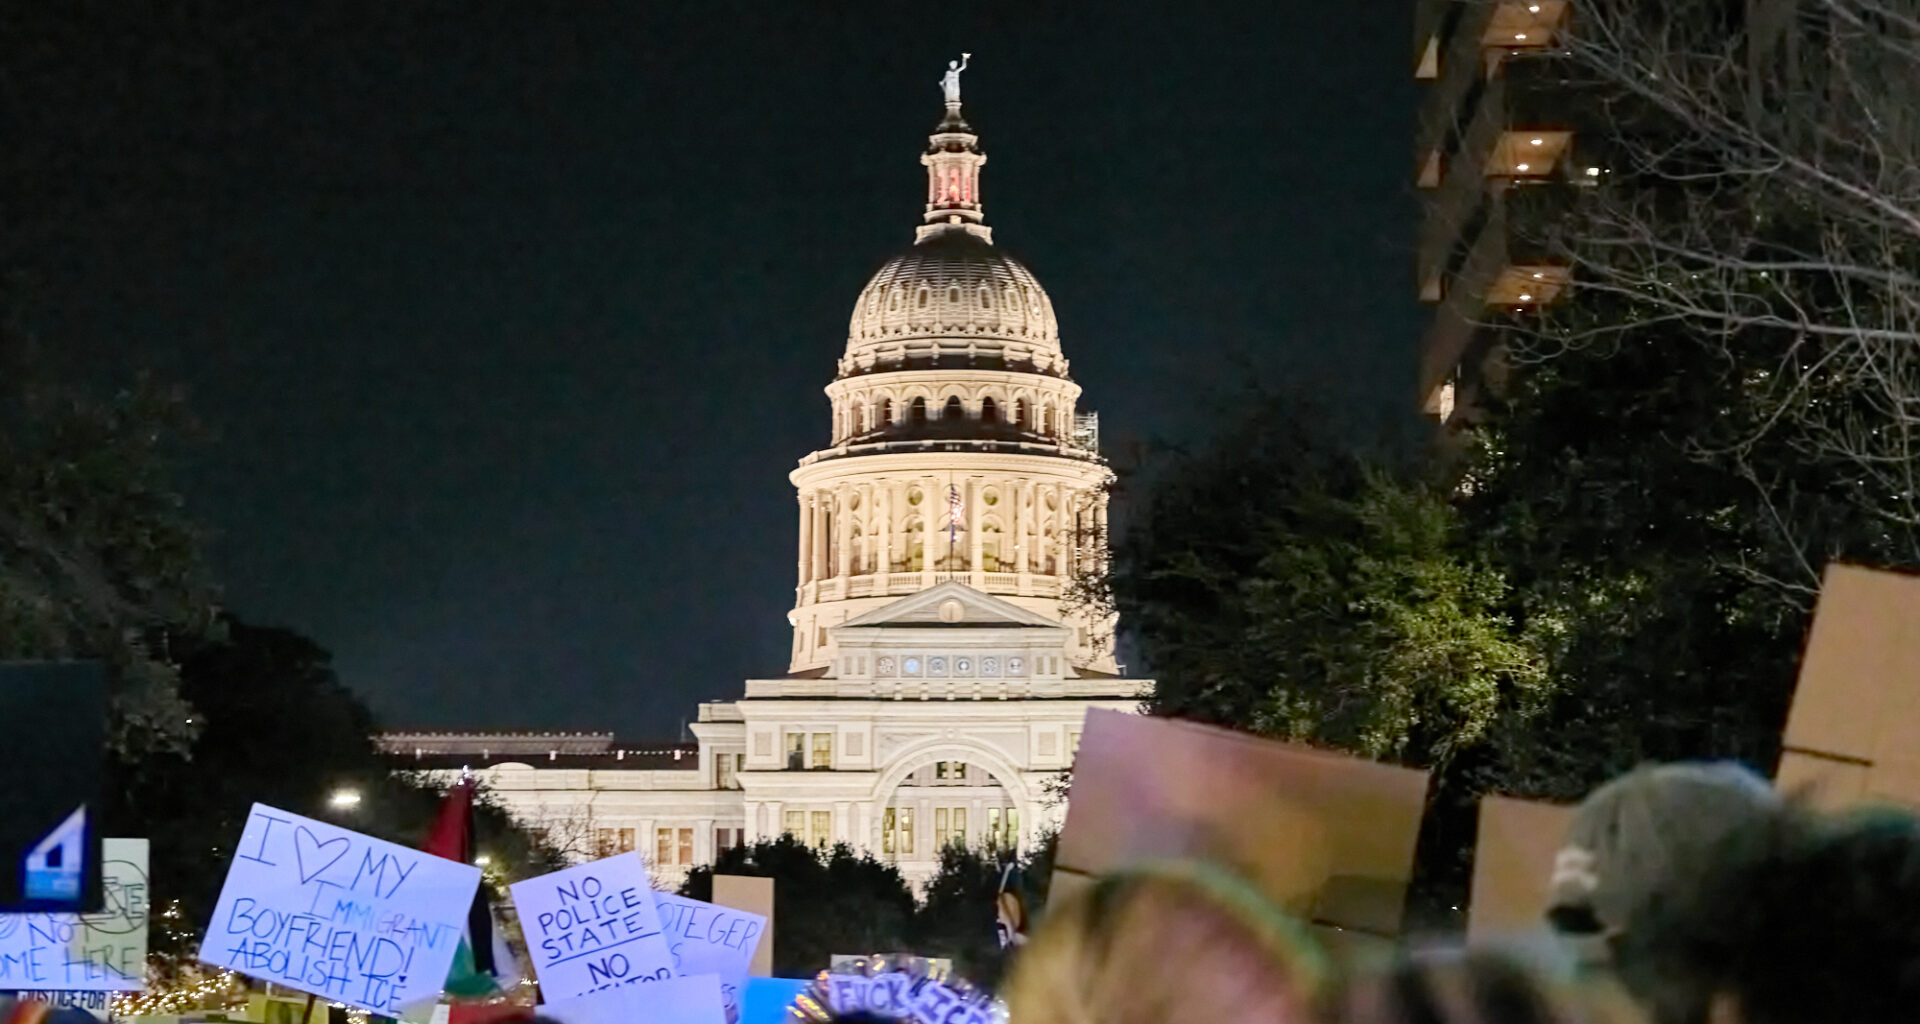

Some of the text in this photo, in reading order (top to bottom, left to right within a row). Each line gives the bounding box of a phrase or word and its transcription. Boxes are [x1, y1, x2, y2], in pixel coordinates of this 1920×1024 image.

[239, 812, 418, 900] I MY
[300, 878, 461, 949] IMMIGRANT
[537, 887, 641, 936] POLICE
[556, 875, 602, 906] NO
[28, 914, 107, 947] NOT
[226, 897, 415, 984] BOYFRIEND!
[541, 911, 645, 961] STATE
[61, 944, 139, 984] HERE
[227, 937, 408, 1015] ABOLISH ICE
[586, 953, 630, 986] NO
[80, 990, 107, 1011] FOR
